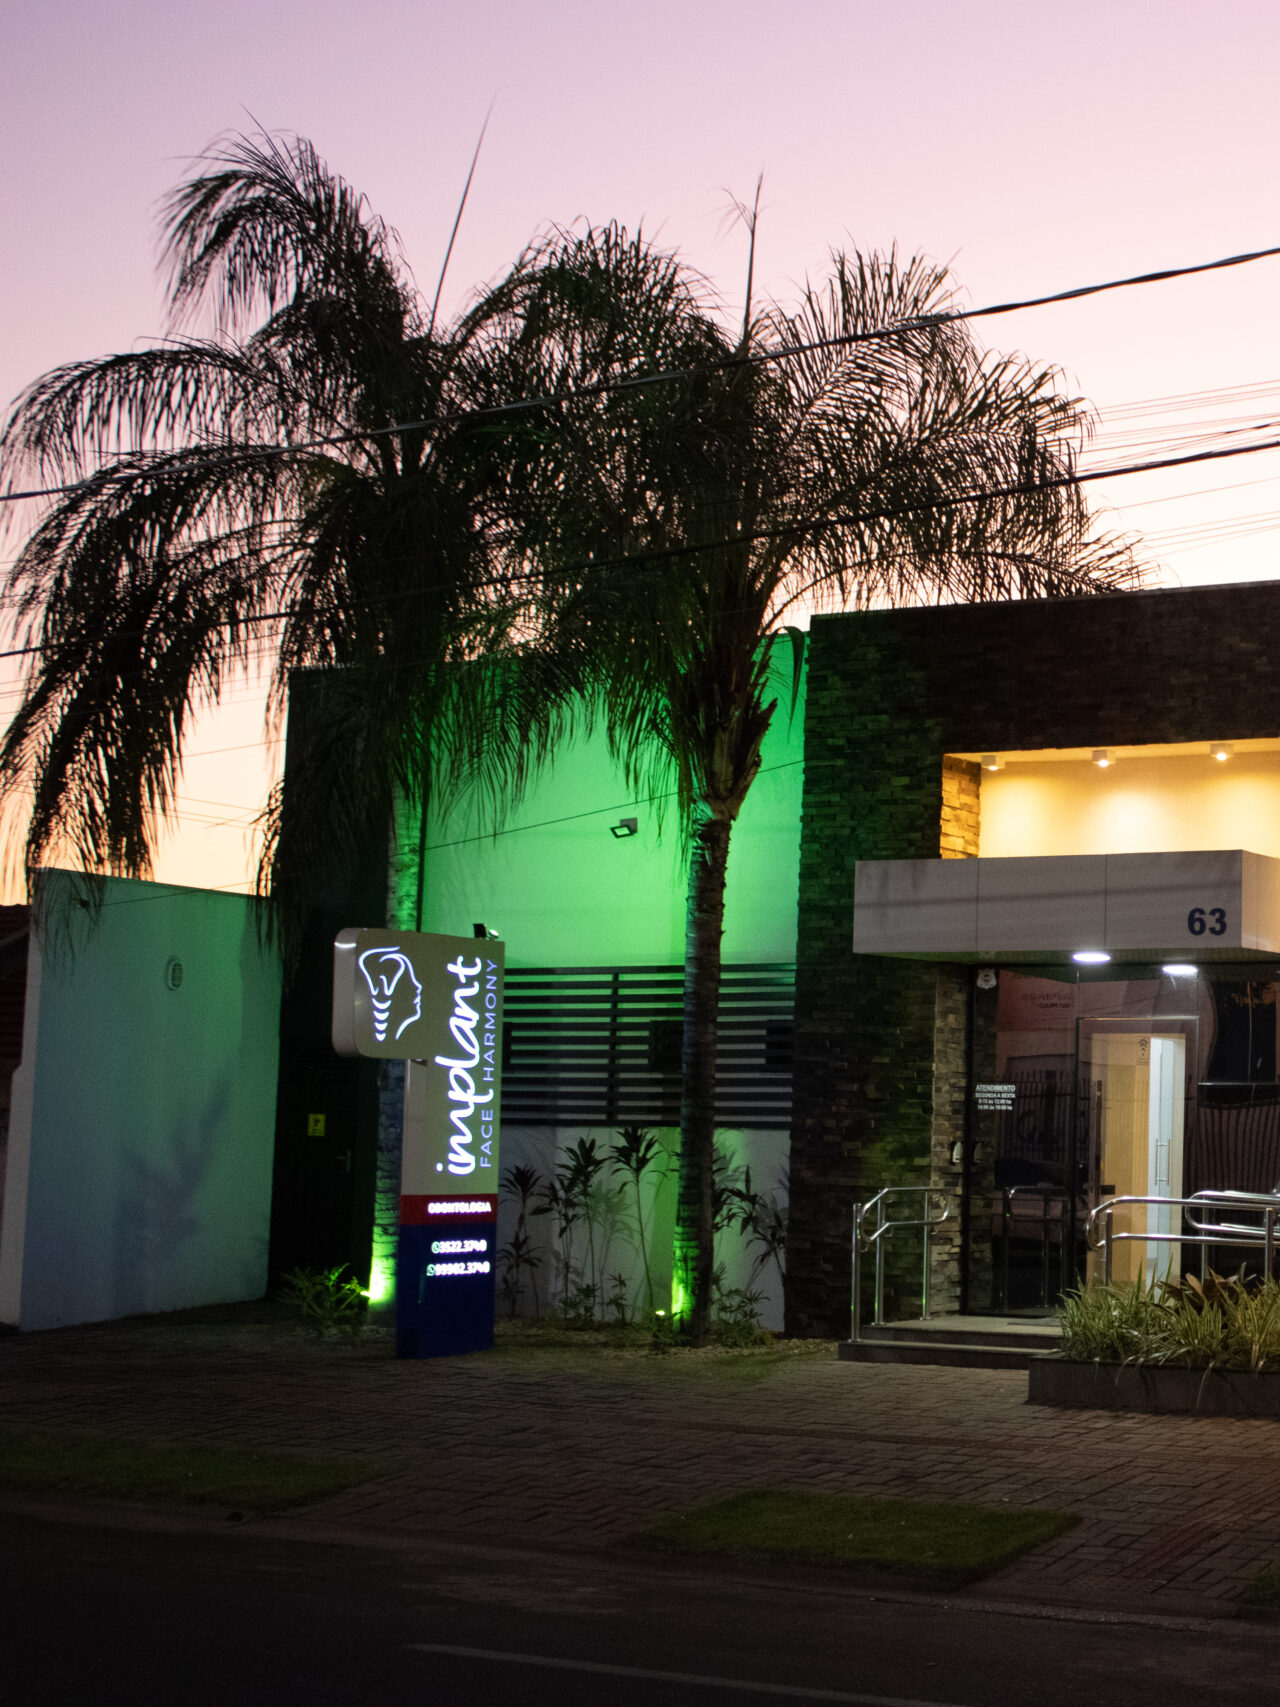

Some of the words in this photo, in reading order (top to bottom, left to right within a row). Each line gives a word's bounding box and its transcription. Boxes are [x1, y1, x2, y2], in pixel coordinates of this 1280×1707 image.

[1187, 908, 1227, 936] 63
[483, 959, 498, 1081] HARMONY
[434, 955, 494, 1175] implant
[975, 1084, 1016, 1092] ATENDIMENTO
[480, 1108, 493, 1168] FACE
[427, 1201, 492, 1214] ODONTOLOGIA
